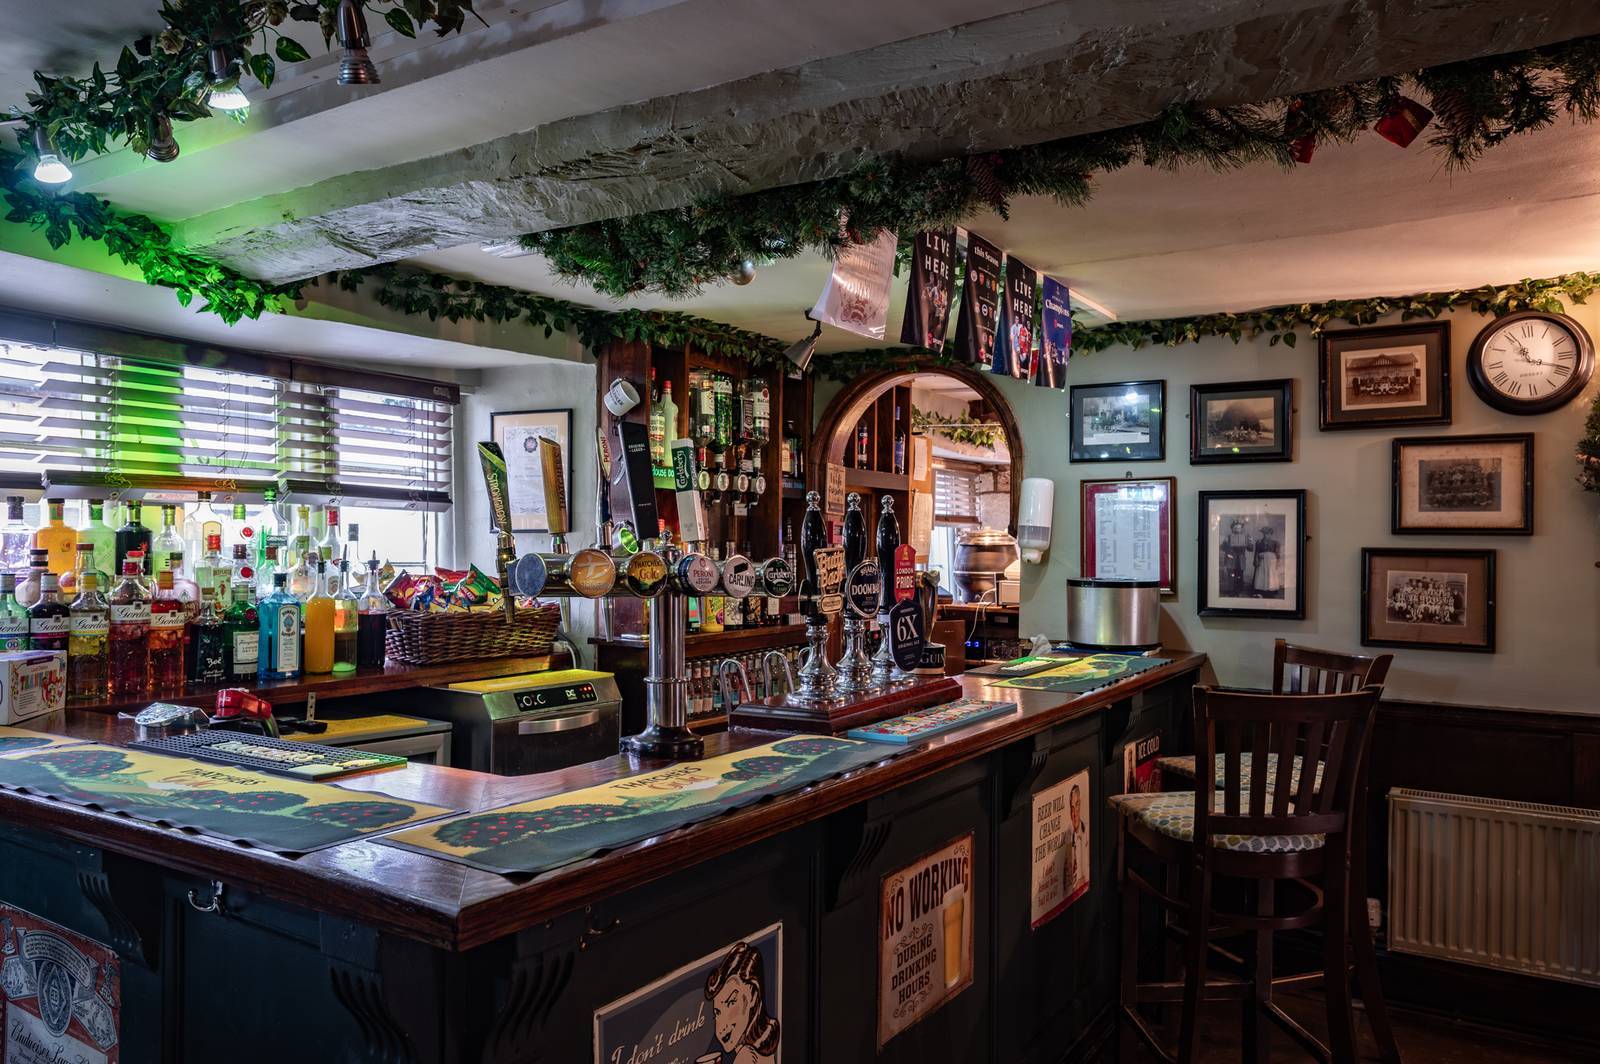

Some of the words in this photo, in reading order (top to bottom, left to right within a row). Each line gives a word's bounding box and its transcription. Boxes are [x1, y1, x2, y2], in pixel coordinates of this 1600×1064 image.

[925, 232, 950, 257] LIVE
[974, 246, 985, 258] this
[924, 254, 950, 280] HERE
[1014, 279, 1032, 299] LIVE
[1013, 298, 1033, 318] HERE
[600, 436, 609, 463] PERONI
[677, 450, 688, 488] Carlsberg
[486, 472, 508, 524] STRONGBOW
[692, 569, 714, 578] PERONI
[766, 567, 794, 580] Carlsberg
[896, 567, 914, 575] LONDON
[896, 576, 914, 589] PRIDE
[896, 614, 920, 643] 6X
[1137, 742, 1147, 761] ICE
[1147, 736, 1160, 756] COLD
[181, 767, 266, 786] THATCHERS
[609, 766, 702, 790] THATCHERS
[1037, 802, 1052, 823] BEER
[1052, 795, 1065, 815] WILL
[1039, 814, 1062, 841] CHANGE
[1034, 842, 1047, 864] THE
[1046, 831, 1072, 856] WORLD
[885, 886, 905, 941] NO
[908, 857, 969, 922] WORKING
[896, 933, 933, 969] DURING
[891, 948, 937, 991] DRINKING
[898, 970, 931, 1005] HOURS
[11, 1018, 50, 1058] Budweiser
[626, 1032, 664, 1064] don't
[668, 1002, 706, 1047] drink
